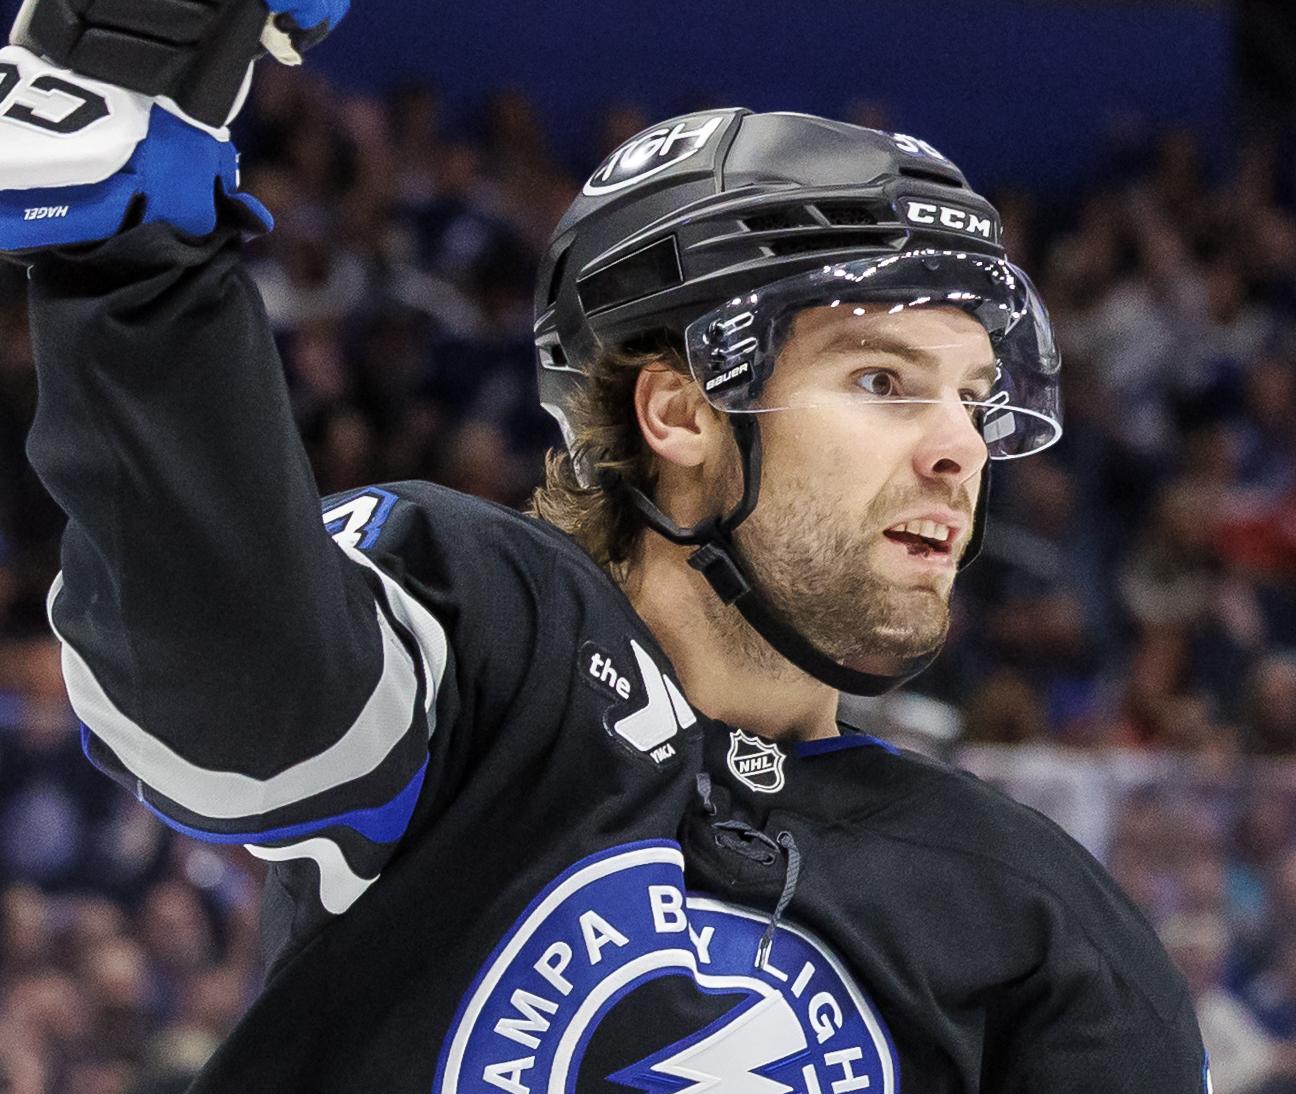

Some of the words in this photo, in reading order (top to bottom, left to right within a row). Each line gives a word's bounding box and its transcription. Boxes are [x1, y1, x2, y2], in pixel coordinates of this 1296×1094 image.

[23, 205, 69, 221] HAGEL
[907, 202, 991, 237] CCM
[706, 363, 749, 390] BAUER
[589, 653, 632, 700] the
[738, 755, 774, 774] NHL
